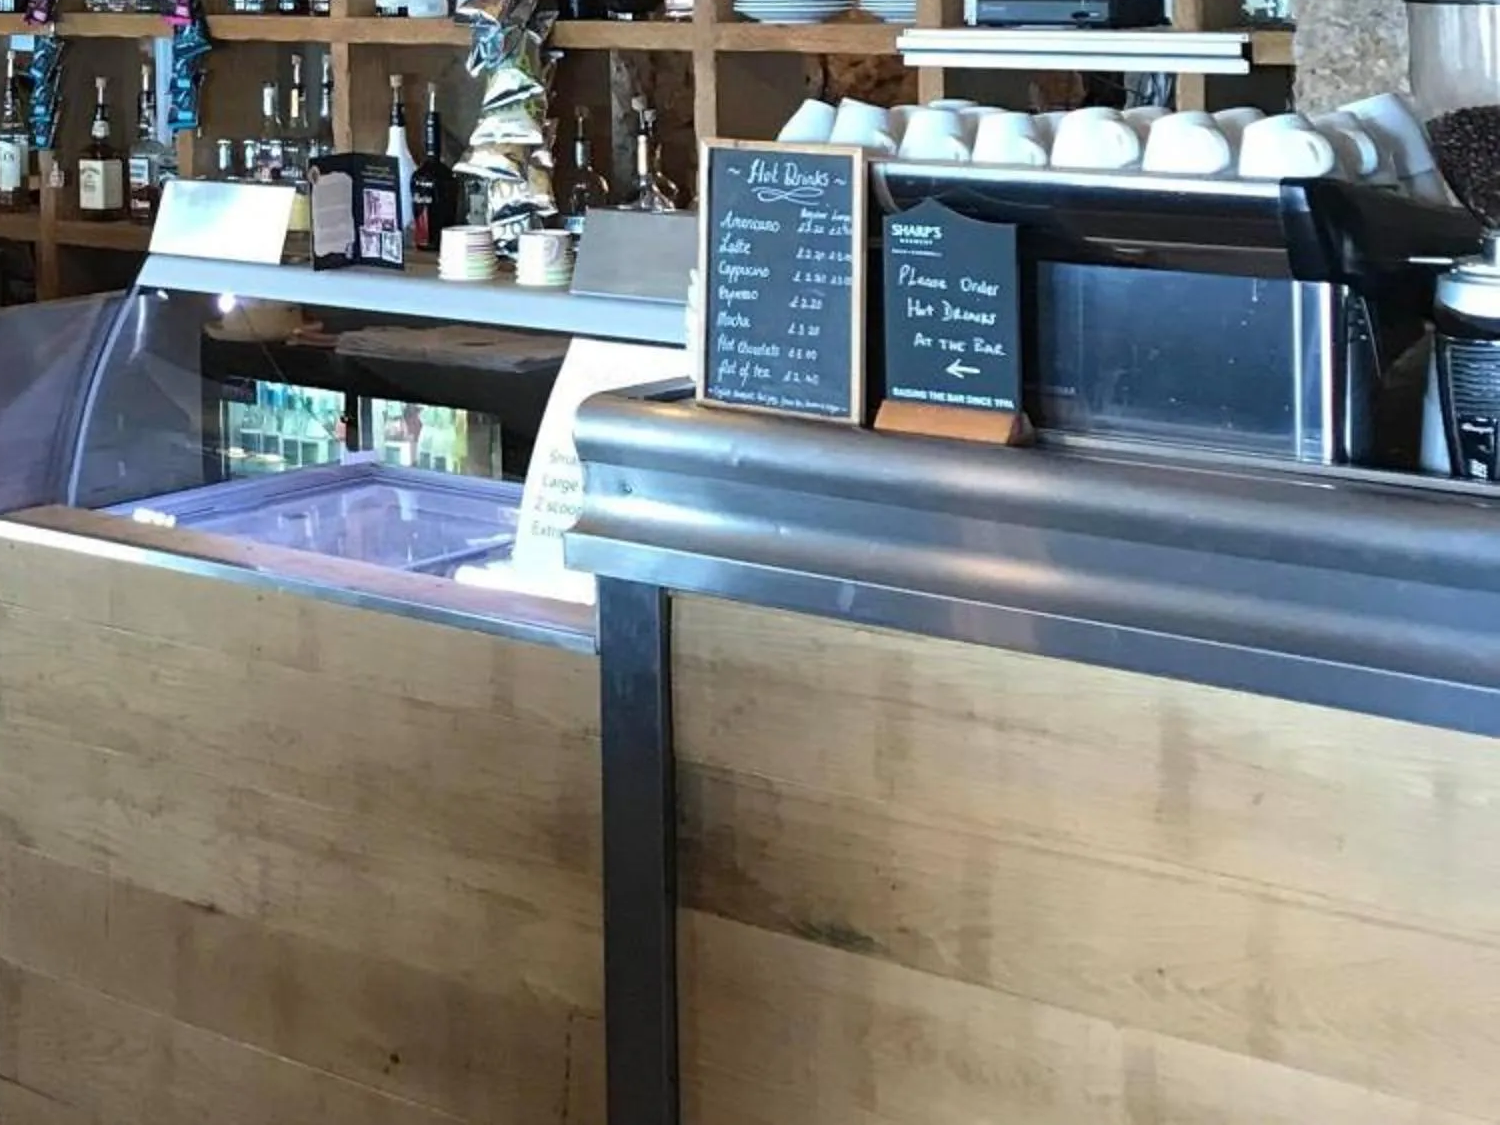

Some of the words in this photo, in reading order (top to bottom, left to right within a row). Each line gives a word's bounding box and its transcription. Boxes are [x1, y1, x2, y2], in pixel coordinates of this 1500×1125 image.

[747, 158, 779, 184] Hot
[784, 162, 829, 187] Drinks
[720, 210, 781, 233] Americano
[891, 224, 942, 239] SHARP'S
[718, 232, 751, 255] Latte
[717, 333, 735, 352] Hot
[542, 473, 580, 494] Large
